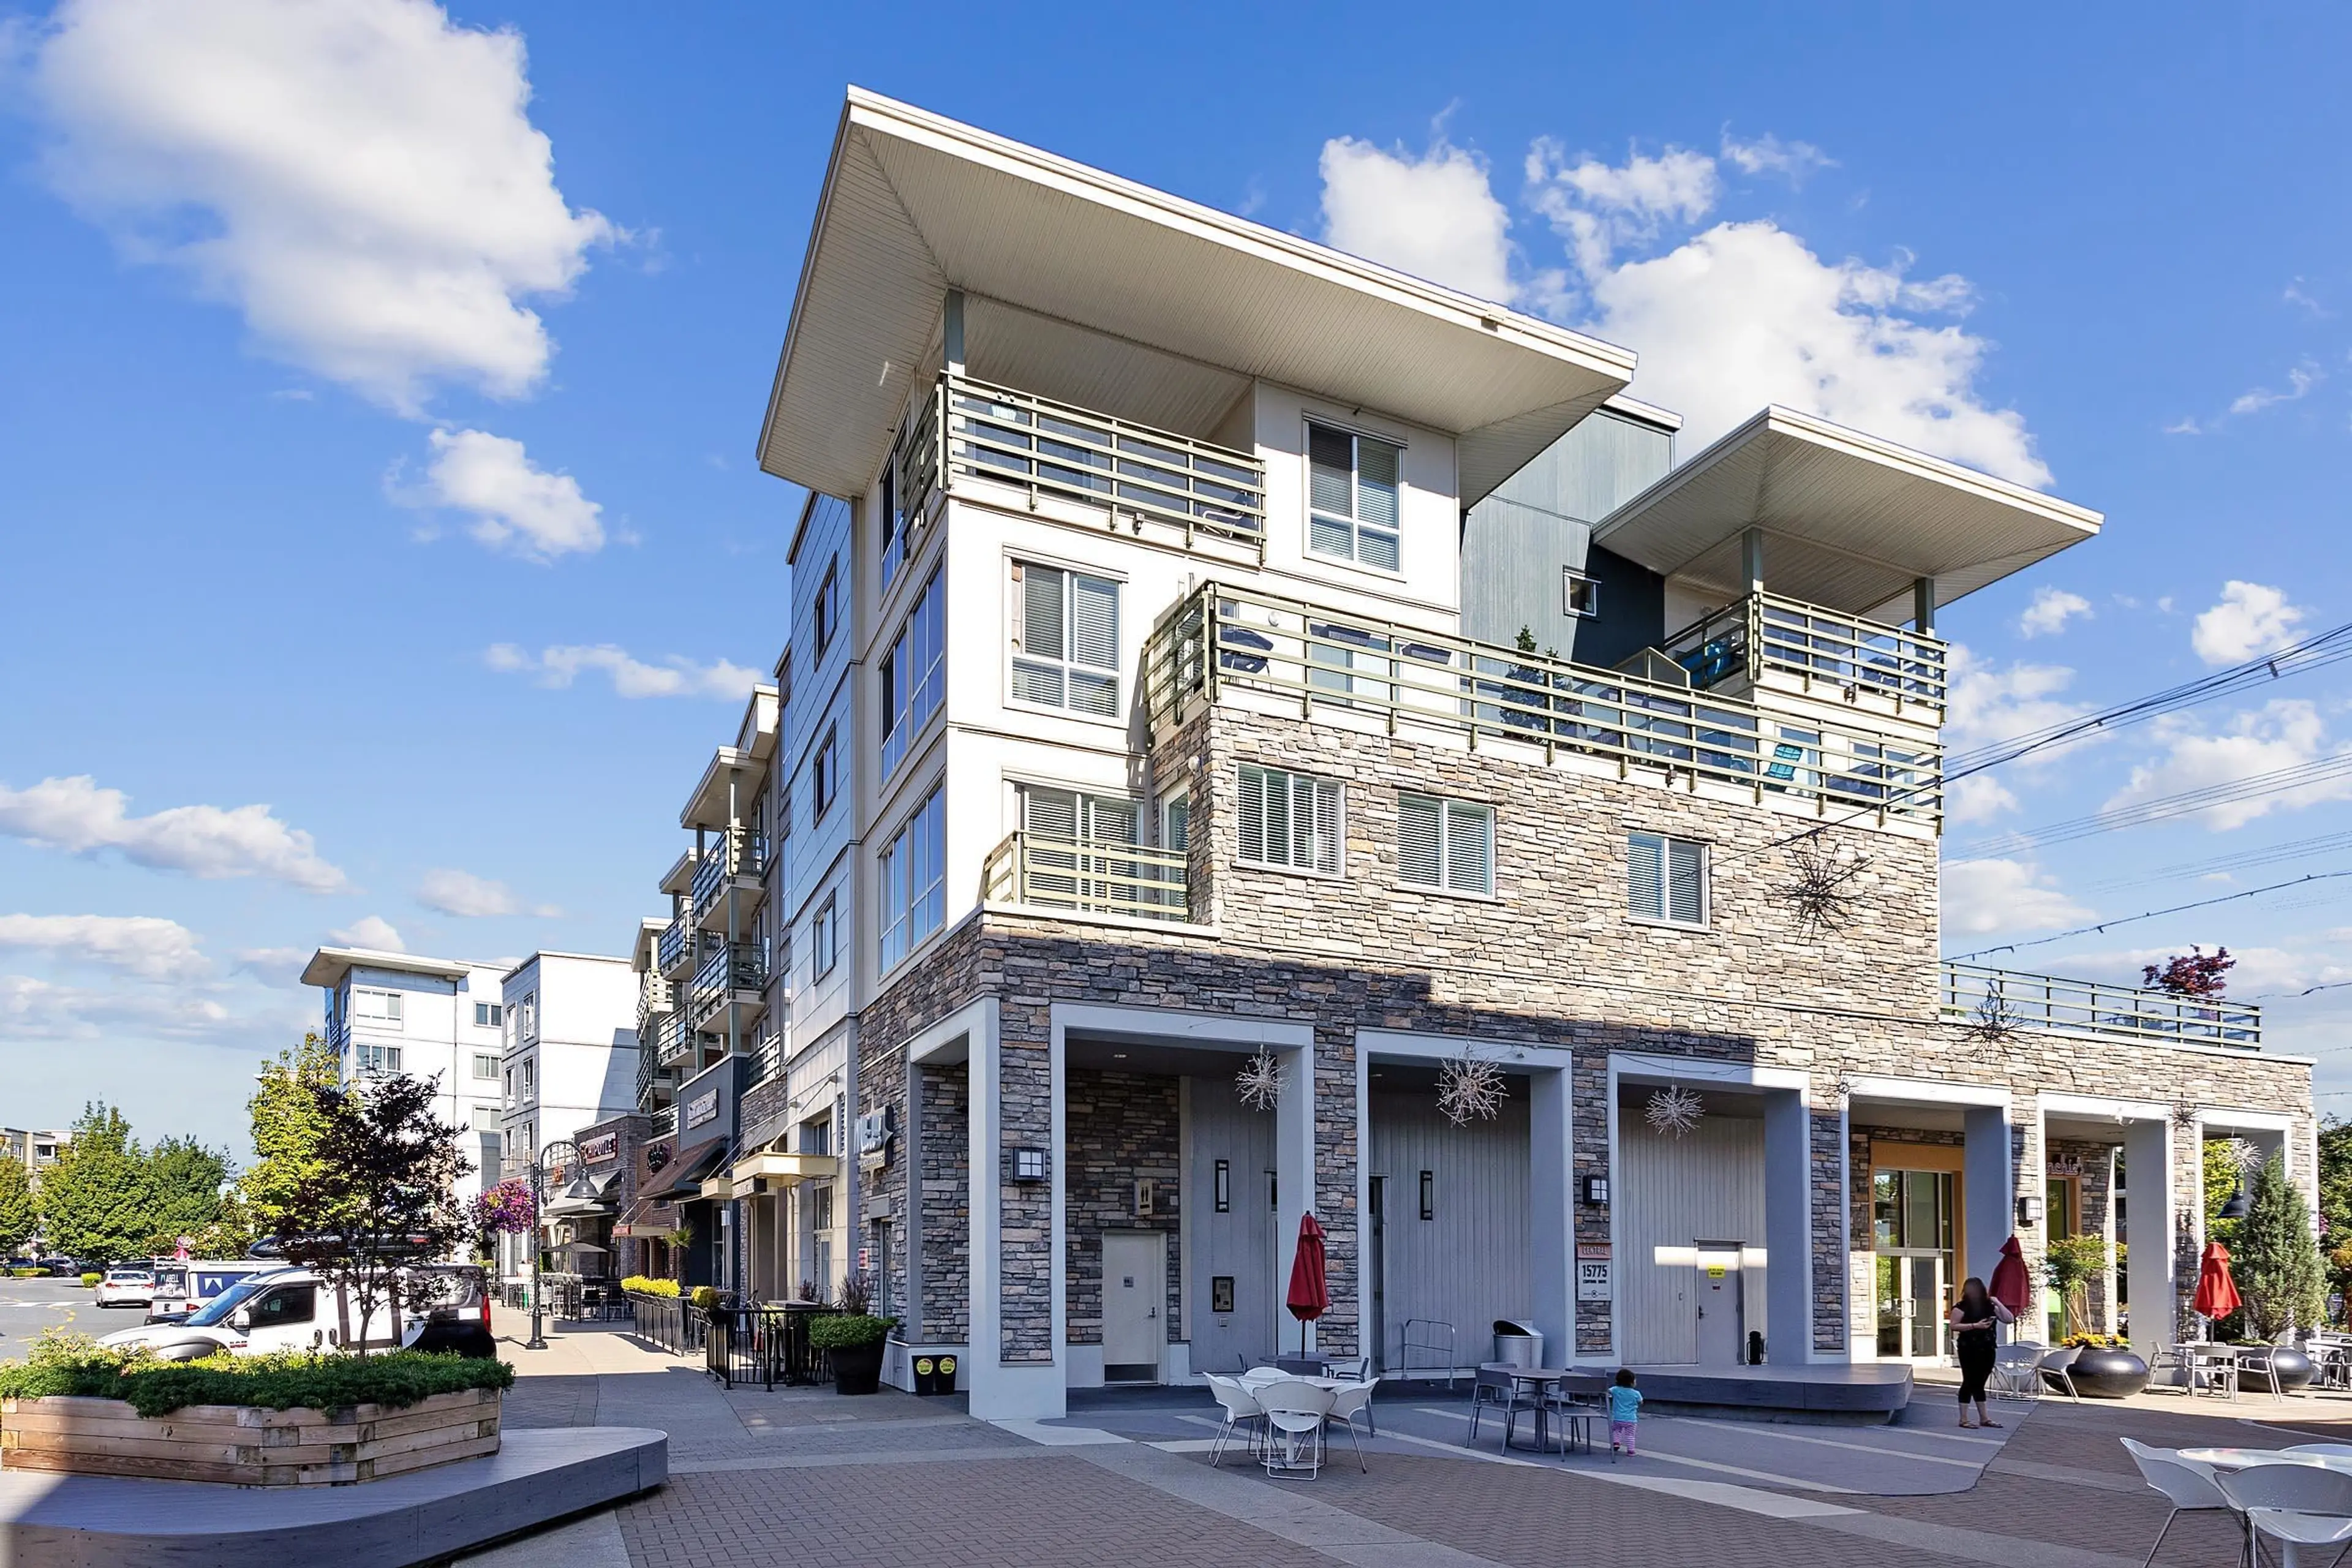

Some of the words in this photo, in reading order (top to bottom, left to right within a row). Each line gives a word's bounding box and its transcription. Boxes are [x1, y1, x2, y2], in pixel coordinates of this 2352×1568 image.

[584, 1139, 612, 1158] CHIPOTLE
[2046, 1154, 2084, 1174] nchie's
[1582, 1246, 1608, 1255] CENTRAL
[1582, 1264, 1607, 1278] 15775
